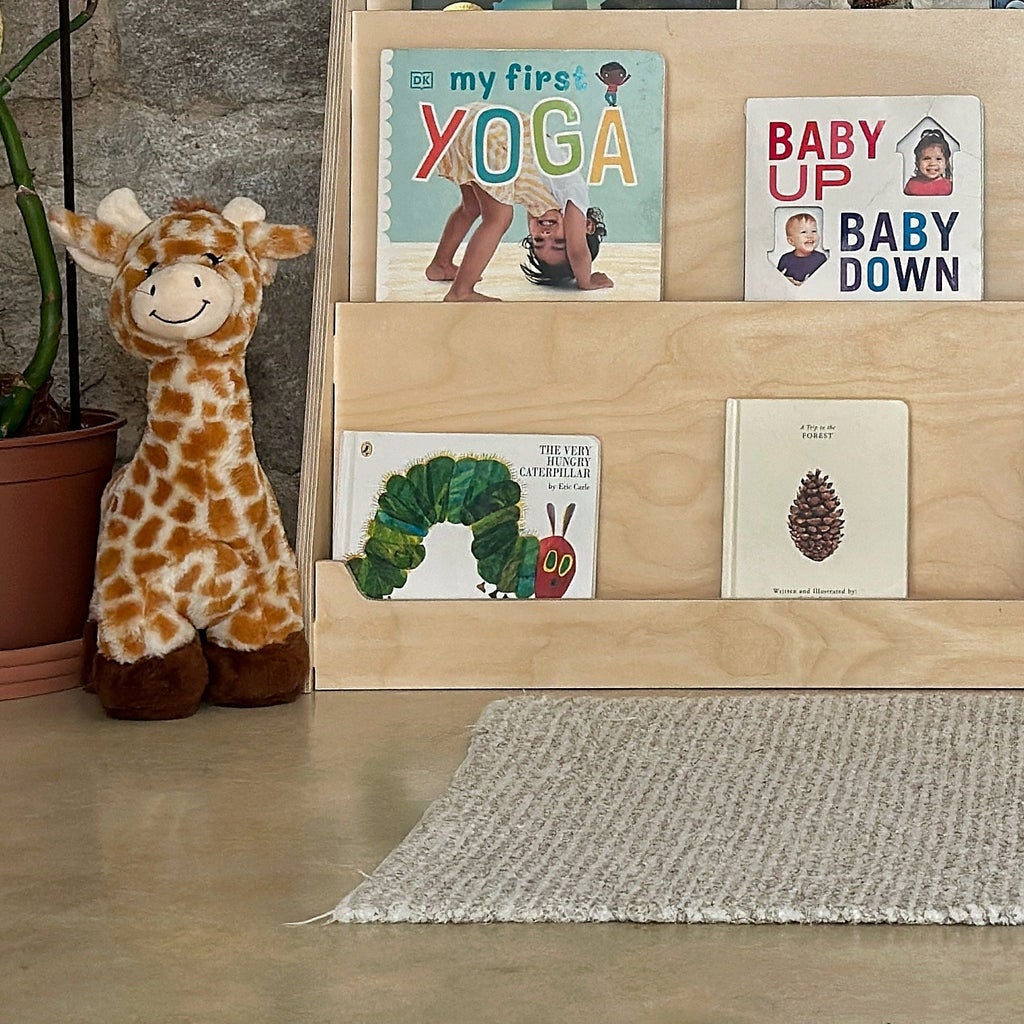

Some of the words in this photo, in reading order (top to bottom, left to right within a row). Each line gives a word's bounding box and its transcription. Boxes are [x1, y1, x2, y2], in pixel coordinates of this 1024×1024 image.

[412, 74, 431, 87] DK
[450, 70, 496, 100] my
[505, 63, 587, 91] first
[412, 97, 638, 187] YOGA
[768, 120, 886, 161] BABY
[769, 164, 851, 202] UP
[840, 211, 960, 252] BABY
[839, 256, 959, 292] DOWN
[540, 444, 561, 455] THE
[564, 445, 592, 456] VERY
[547, 456, 591, 467] HUNGRY
[519, 467, 591, 478] CATERPILLAR
[548, 482, 556, 491] by
